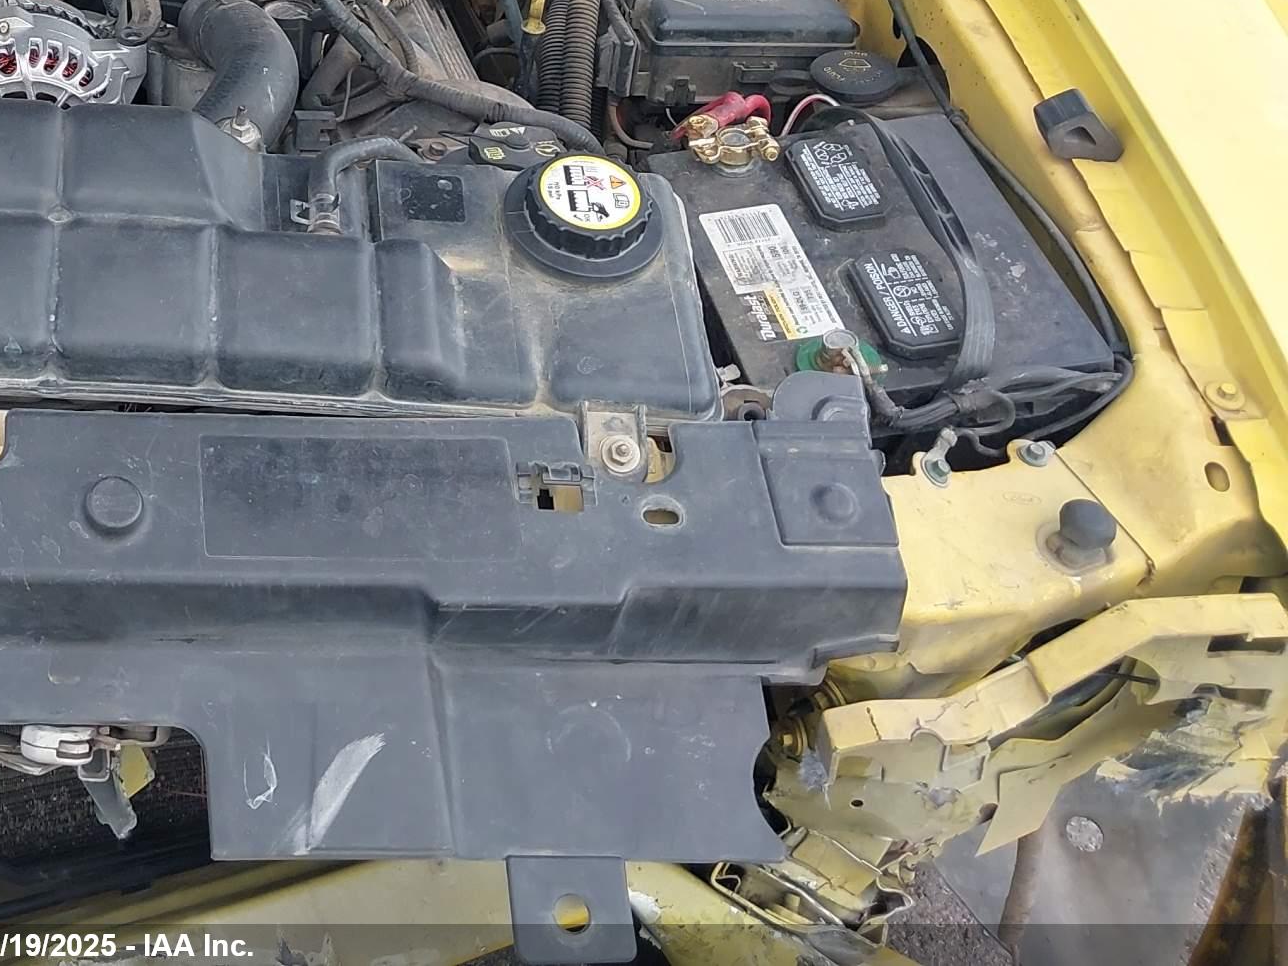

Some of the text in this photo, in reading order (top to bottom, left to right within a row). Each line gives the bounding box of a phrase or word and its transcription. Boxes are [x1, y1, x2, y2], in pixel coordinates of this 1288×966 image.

[863, 262, 886, 290] POISON
[742, 293, 777, 340] Duralast
[882, 295, 907, 327] DANGER
